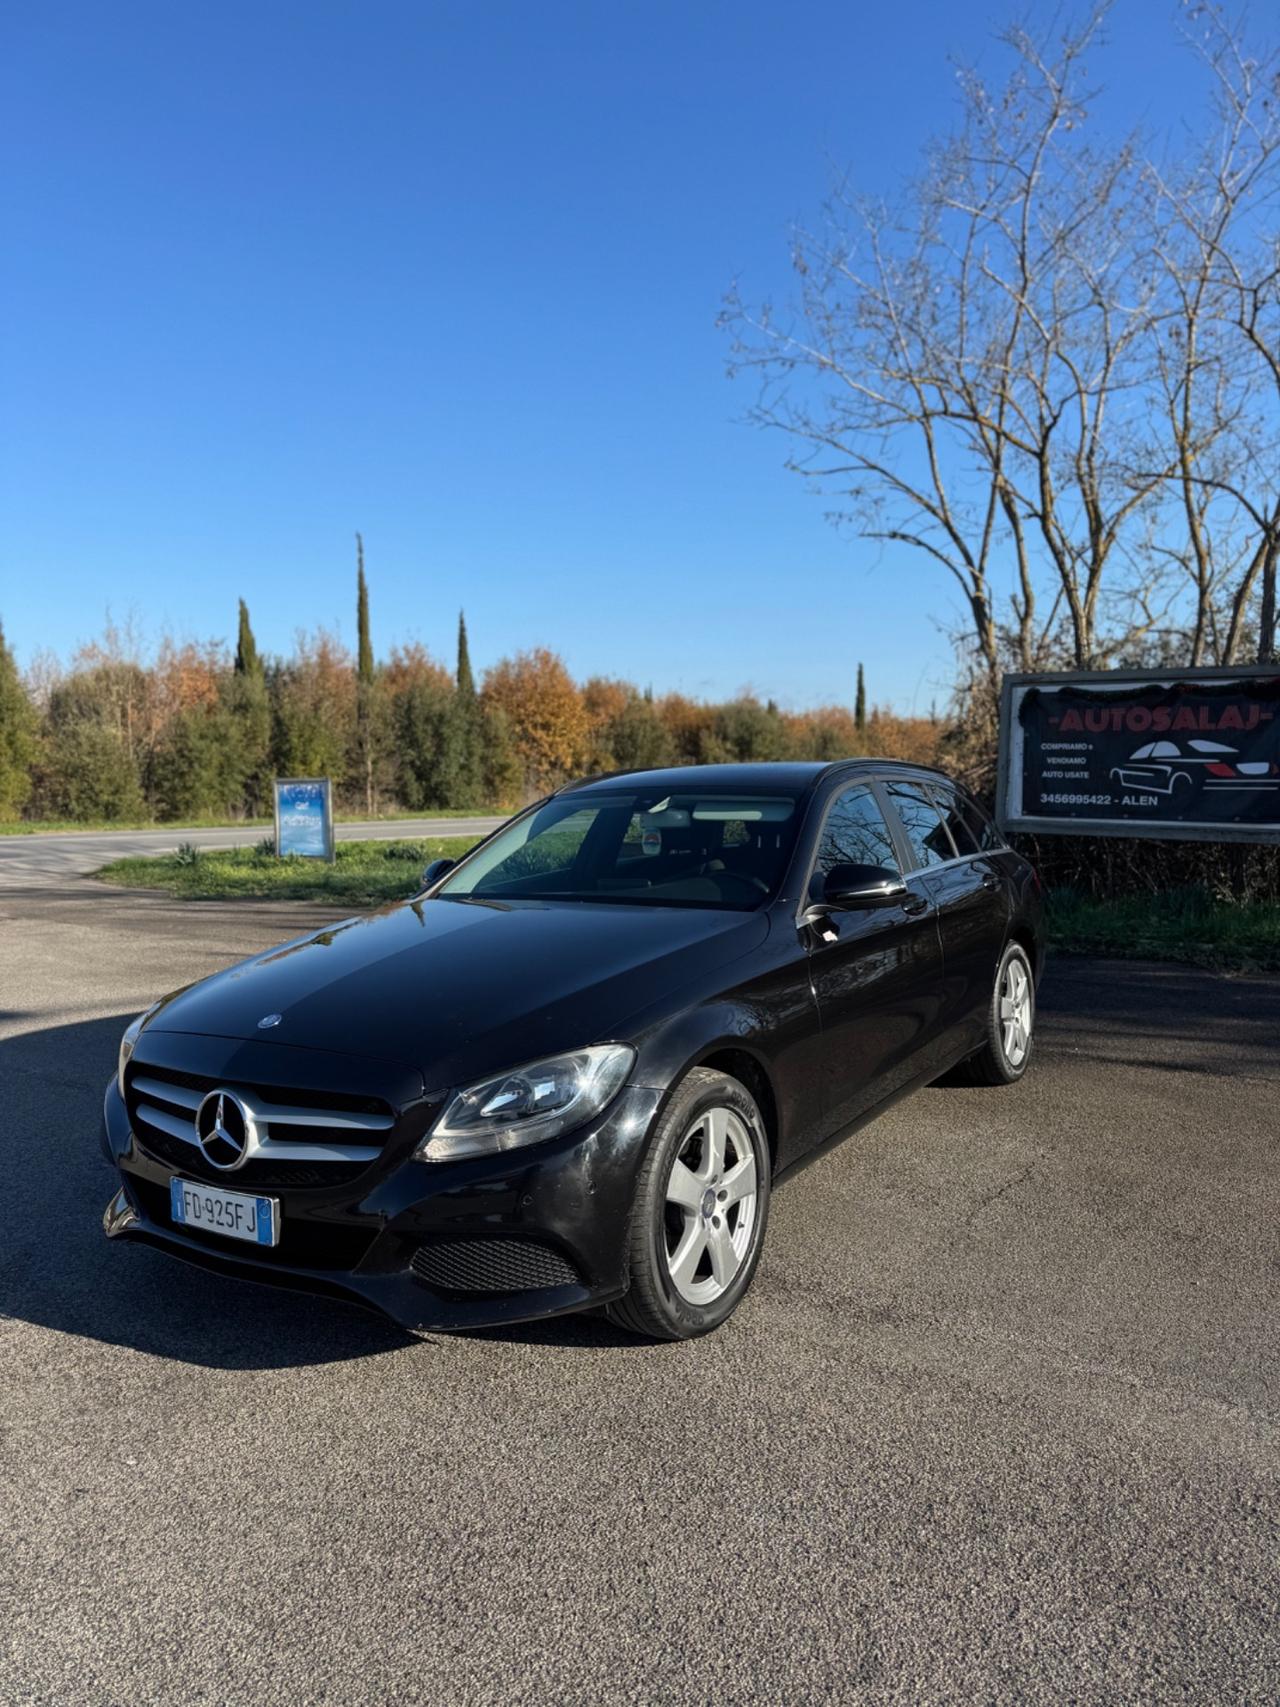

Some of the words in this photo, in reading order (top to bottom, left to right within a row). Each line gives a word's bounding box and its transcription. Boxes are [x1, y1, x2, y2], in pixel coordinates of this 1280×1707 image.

[1040, 742, 1087, 751] COMPRIAMO
[1046, 757, 1087, 765] VENDIAMO
[1041, 770, 1063, 779] AUTO
[1064, 771, 1089, 779] USATE
[1040, 793, 1111, 805] 3456995422
[1121, 795, 1159, 806] ALEN
